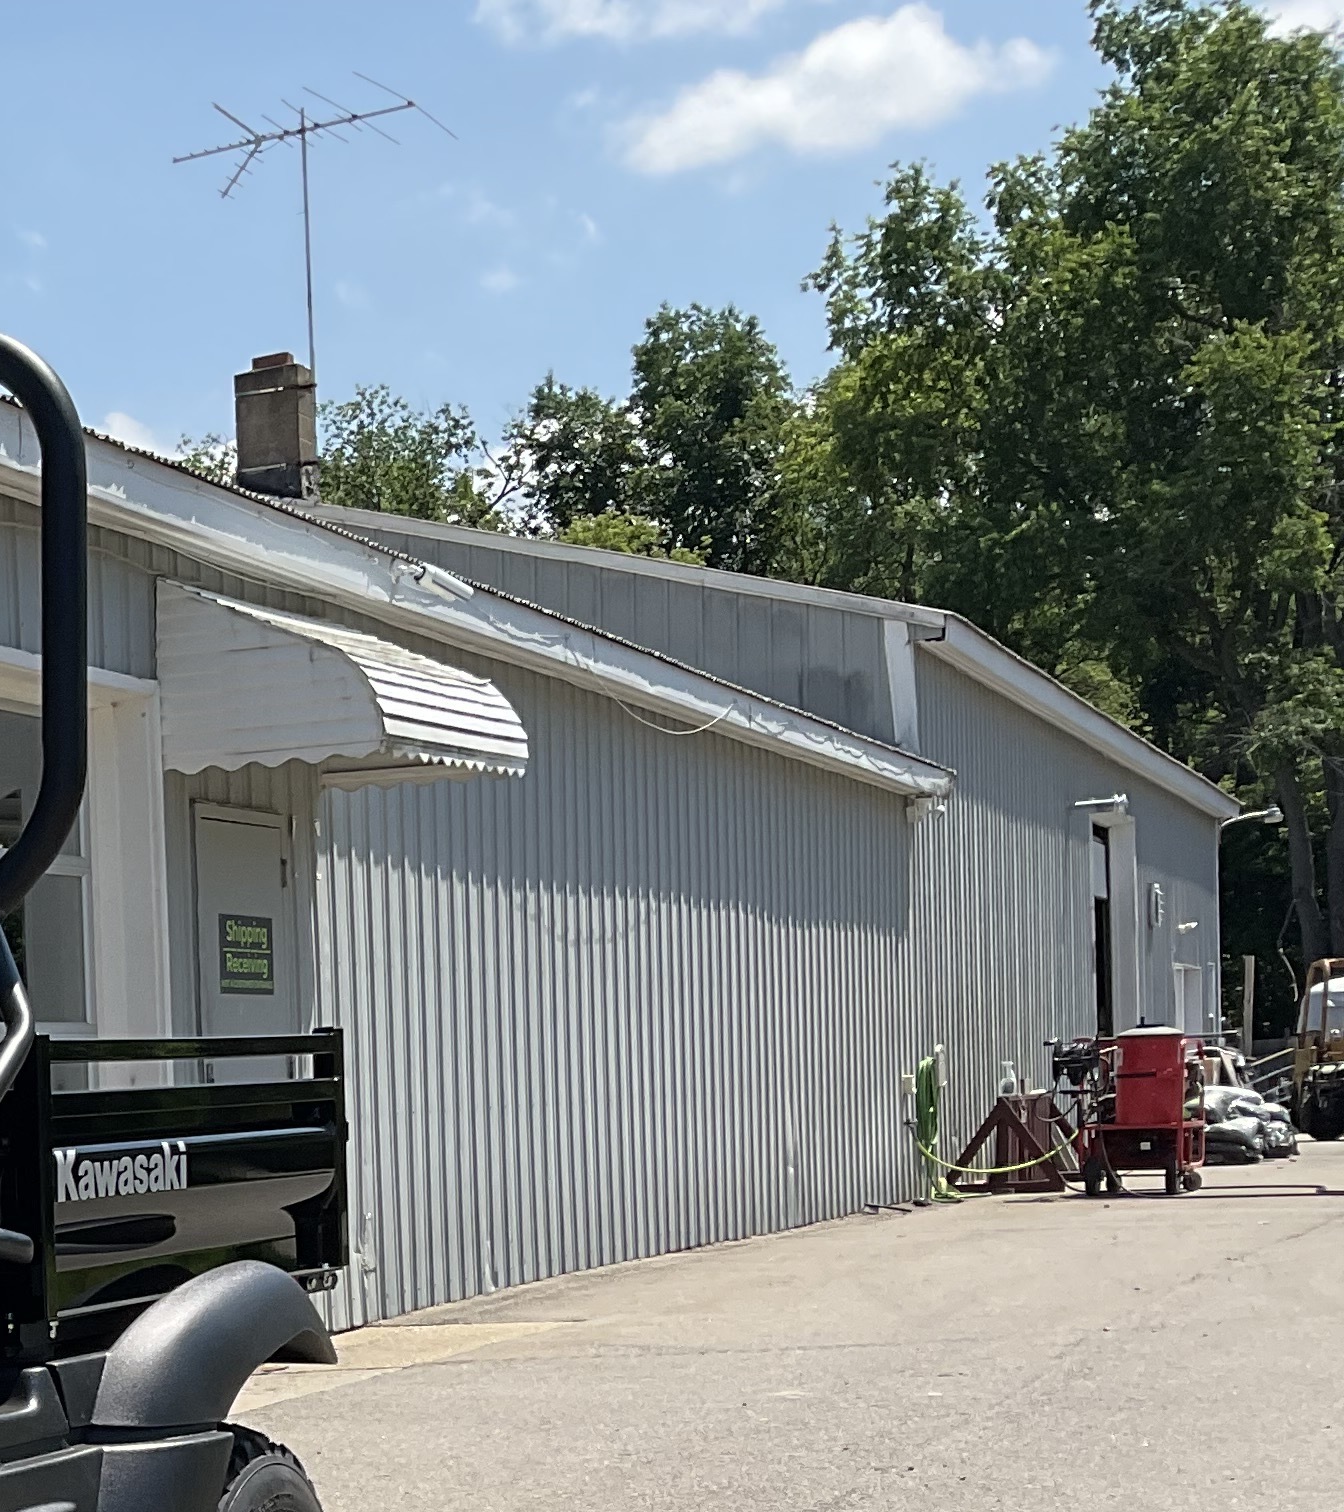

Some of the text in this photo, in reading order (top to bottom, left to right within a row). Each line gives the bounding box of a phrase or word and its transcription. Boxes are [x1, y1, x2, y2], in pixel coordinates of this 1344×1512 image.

[225, 919, 268, 949] Shipping
[225, 952, 269, 979] Receiving
[52, 1140, 189, 1203] Kawasaki
